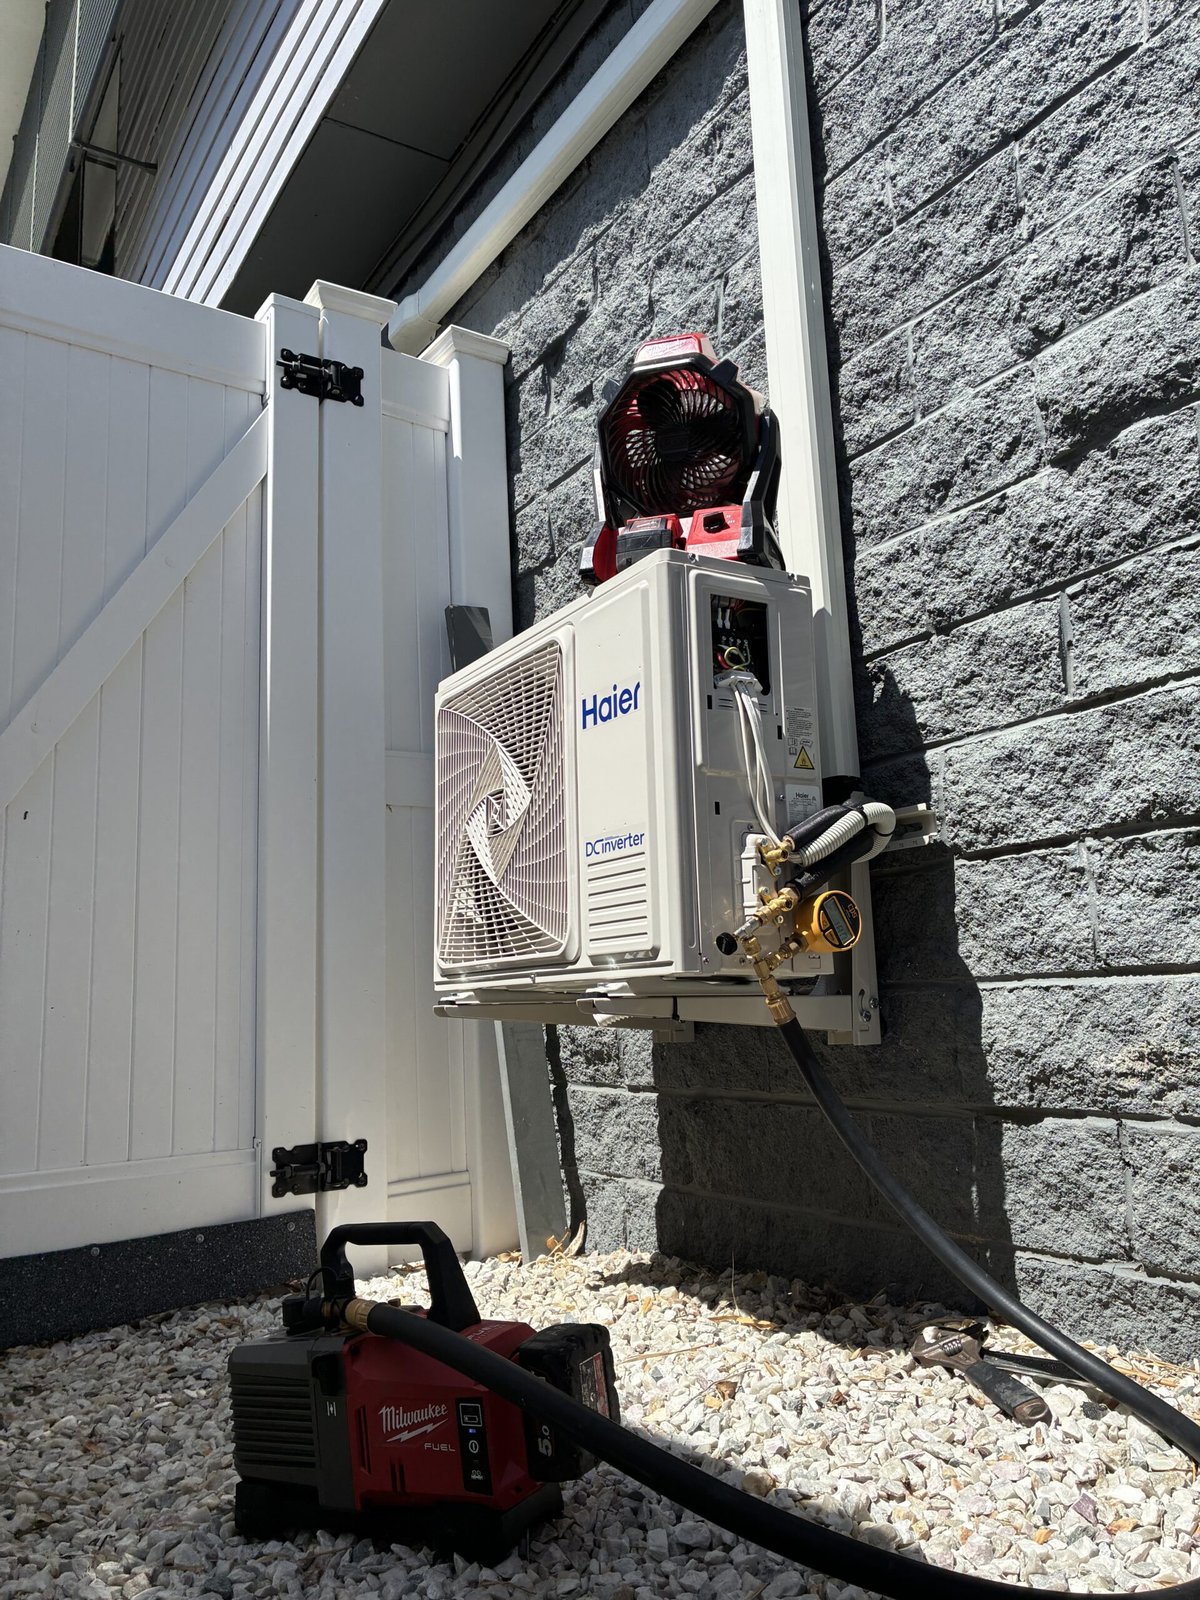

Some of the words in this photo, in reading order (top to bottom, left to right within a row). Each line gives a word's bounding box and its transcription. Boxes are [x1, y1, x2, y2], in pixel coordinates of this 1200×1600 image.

[582, 681, 641, 730] Haier
[378, 1404, 449, 1434] Milwaukee
[424, 1443, 456, 1452] FUEL
